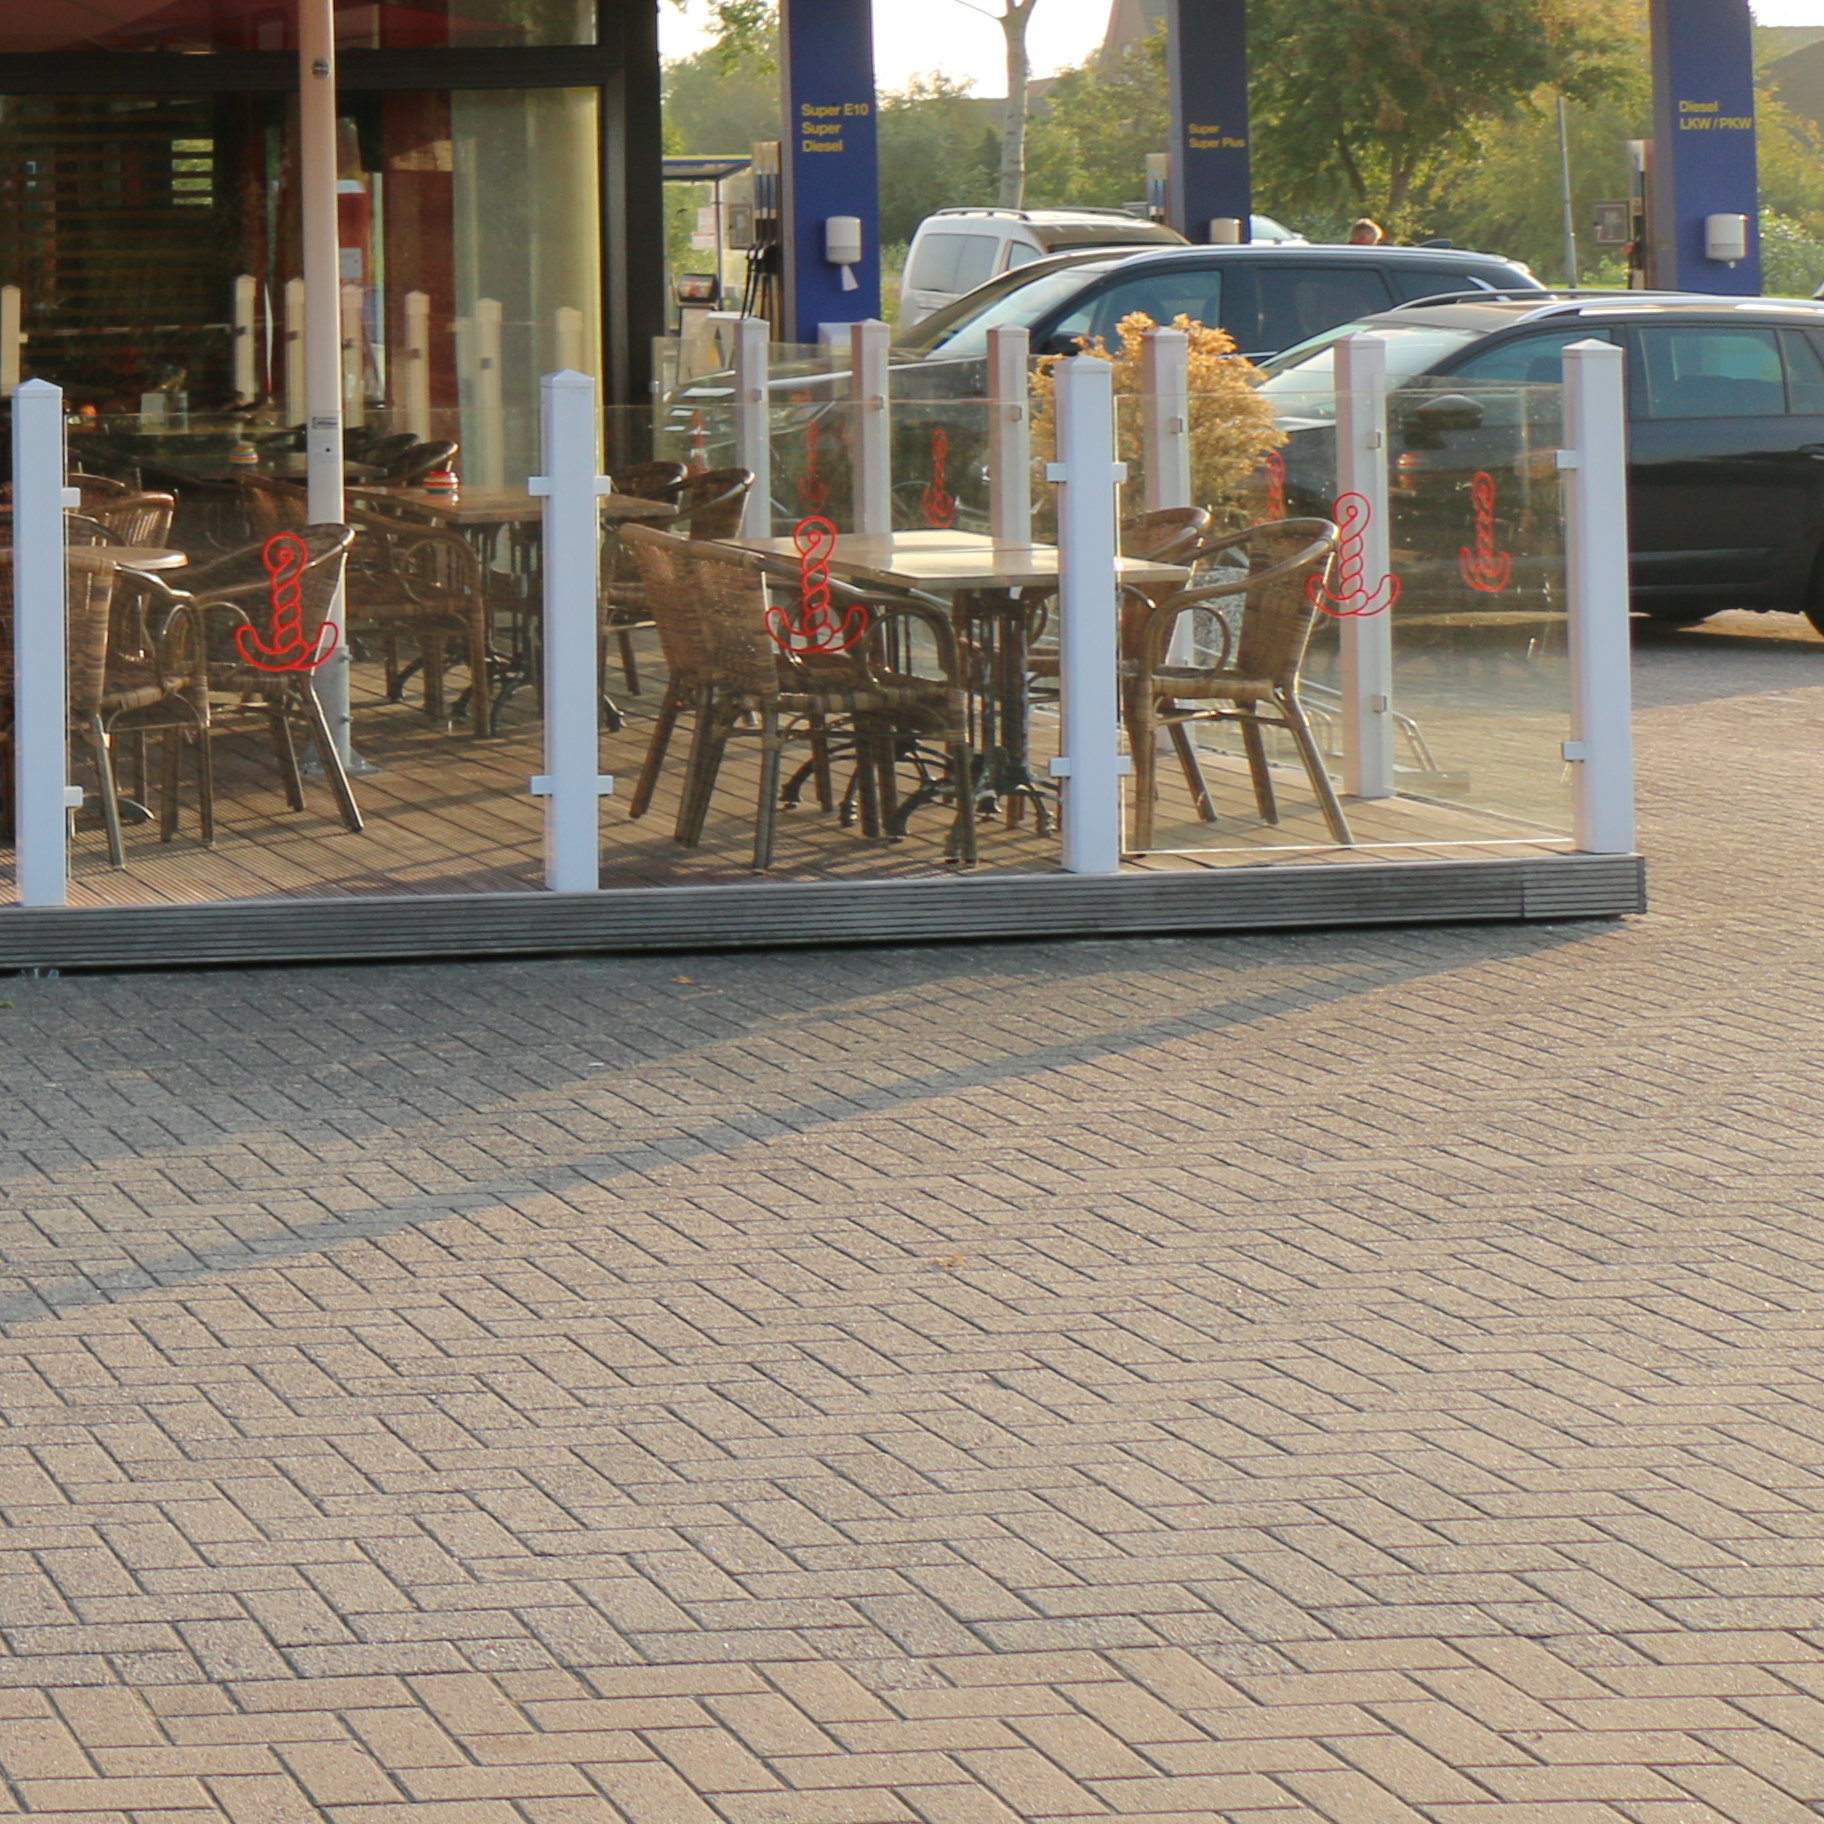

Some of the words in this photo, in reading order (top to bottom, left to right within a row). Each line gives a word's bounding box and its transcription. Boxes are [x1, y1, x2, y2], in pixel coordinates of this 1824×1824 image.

[801, 103, 841, 118] Super
[844, 103, 869, 116] E10
[1679, 100, 1718, 112] Diesel
[801, 121, 842, 136] Super
[1189, 123, 1220, 135] Super
[1680, 117, 1711, 130] LKW
[802, 139, 843, 152] Diesel
[1189, 137, 1220, 149] Super
